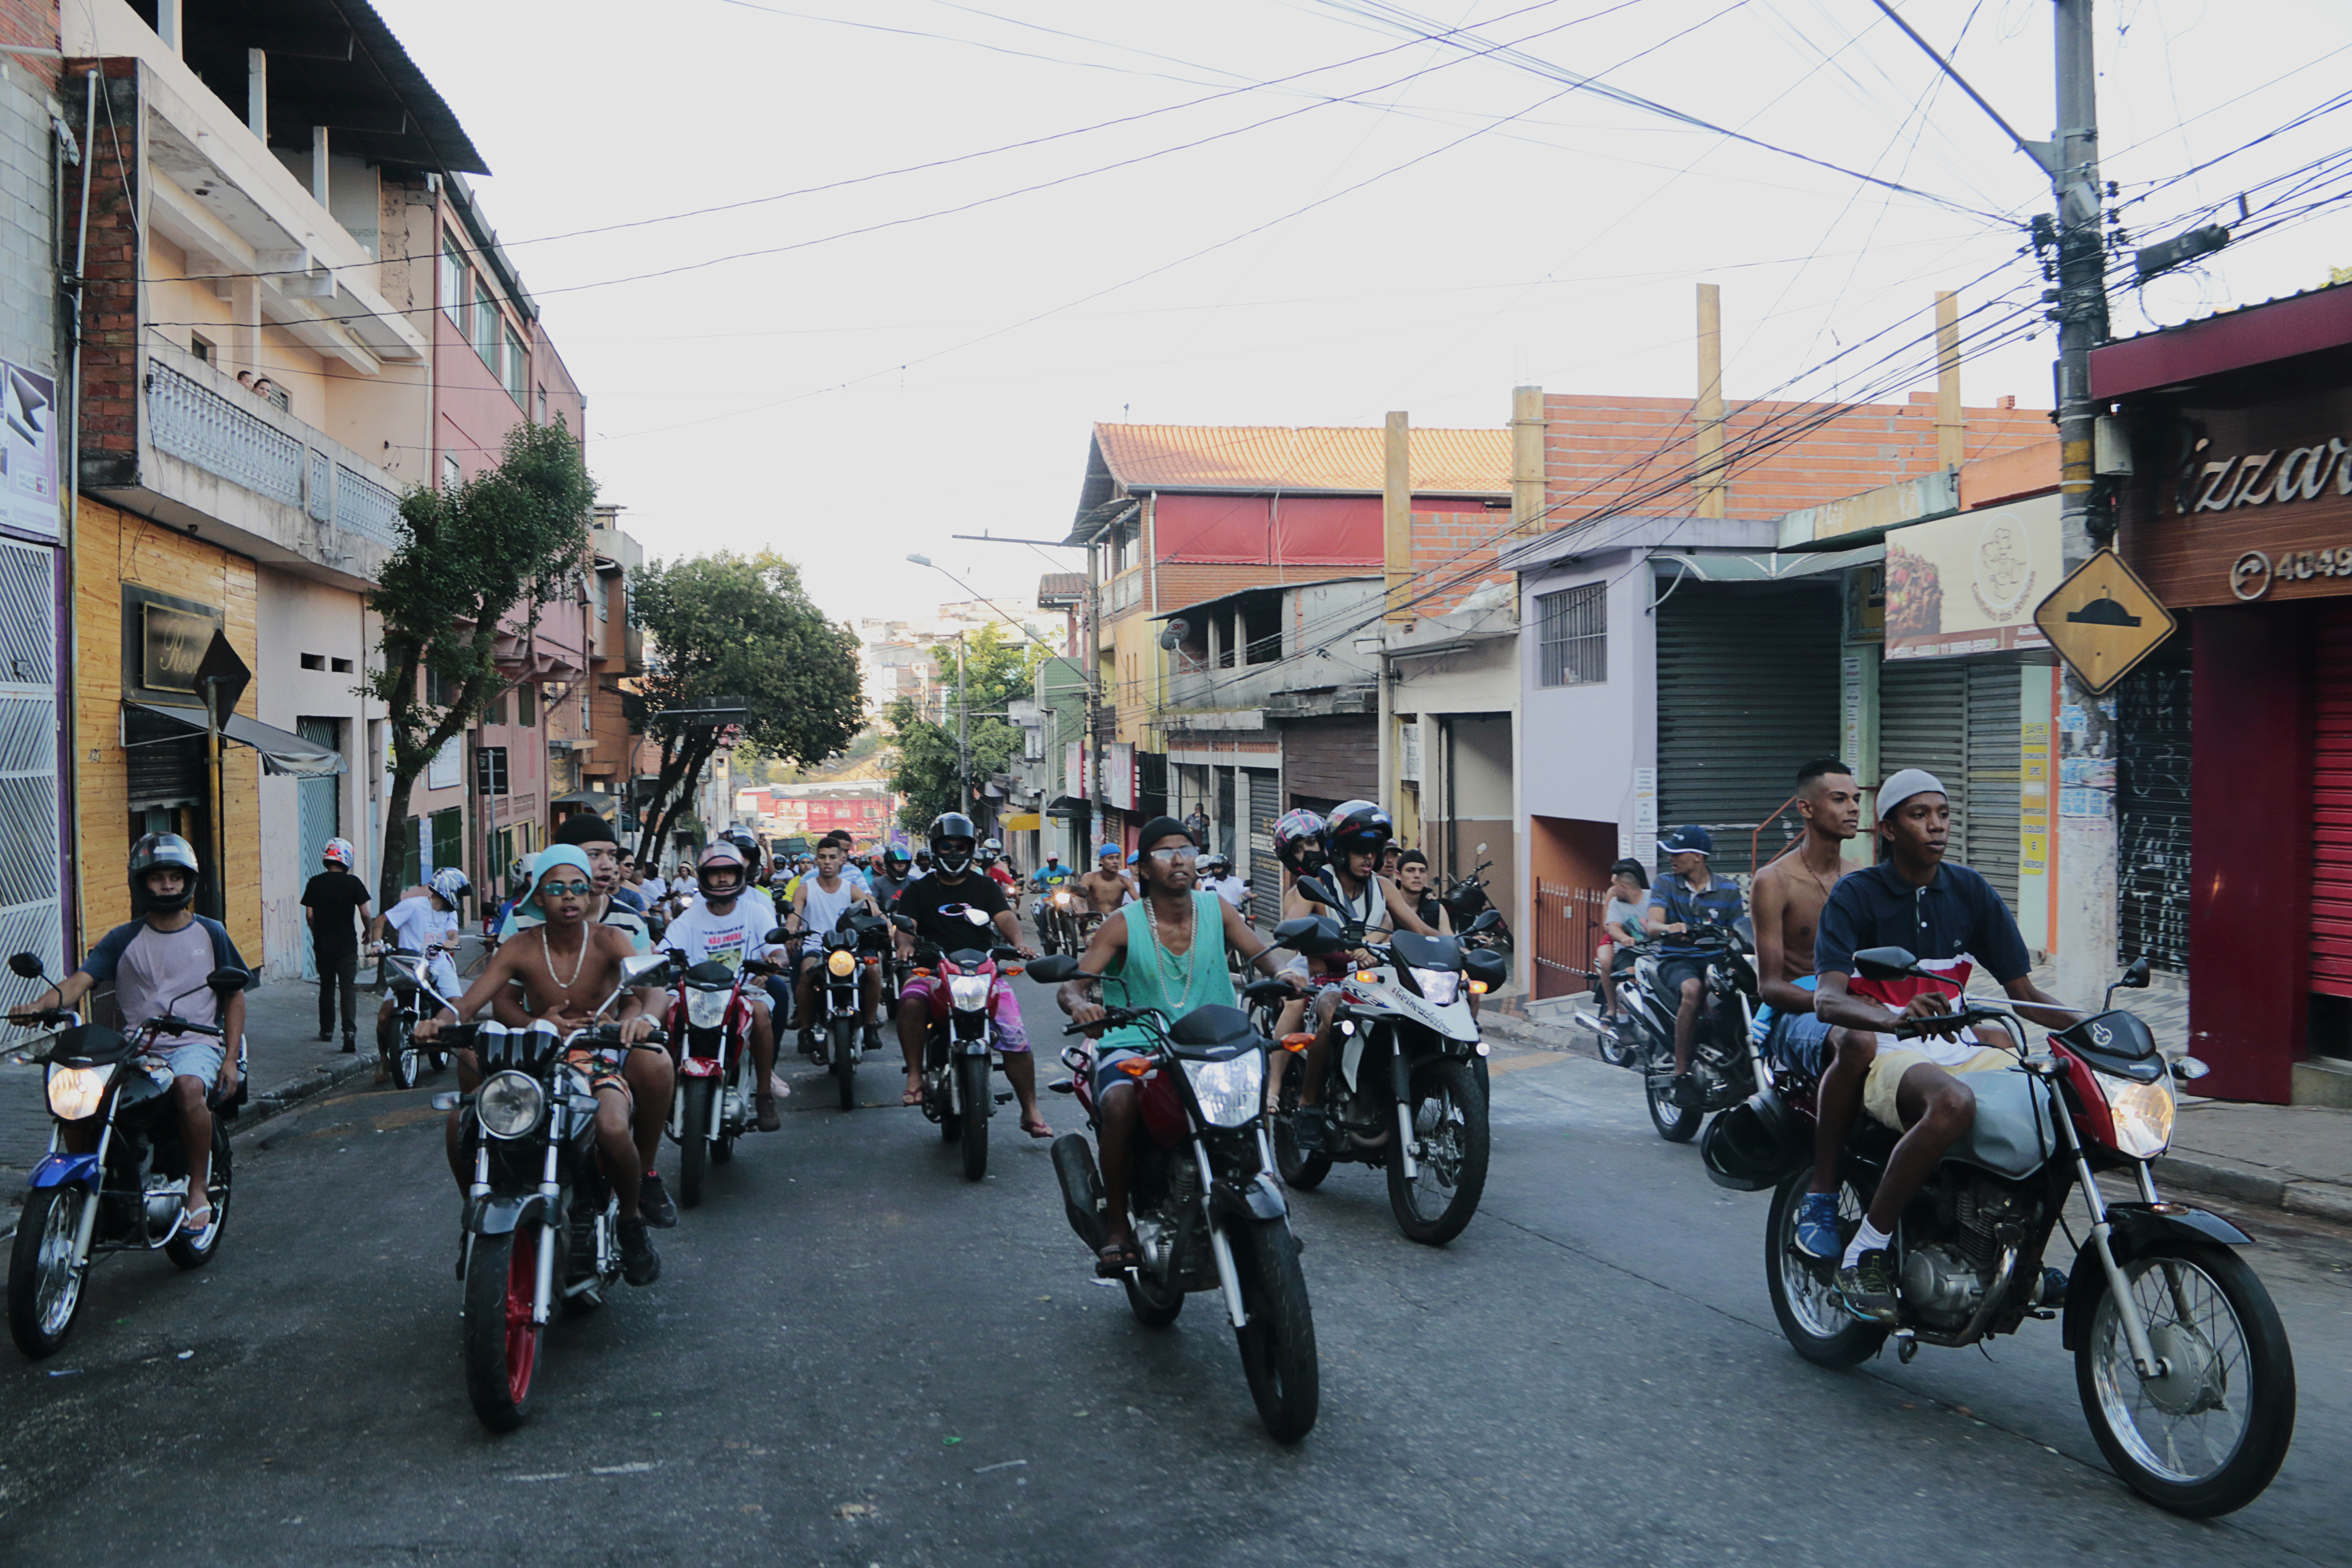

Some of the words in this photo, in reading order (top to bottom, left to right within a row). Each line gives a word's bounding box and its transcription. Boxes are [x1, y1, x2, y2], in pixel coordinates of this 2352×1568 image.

[1348, 822, 1360, 832] Bull
[2024, 825, 2046, 833] COLOR
[2032, 841, 2037, 850] E
[2024, 860, 2045, 869] XEROX
[1205, 1045, 1237, 1054] HONDA
